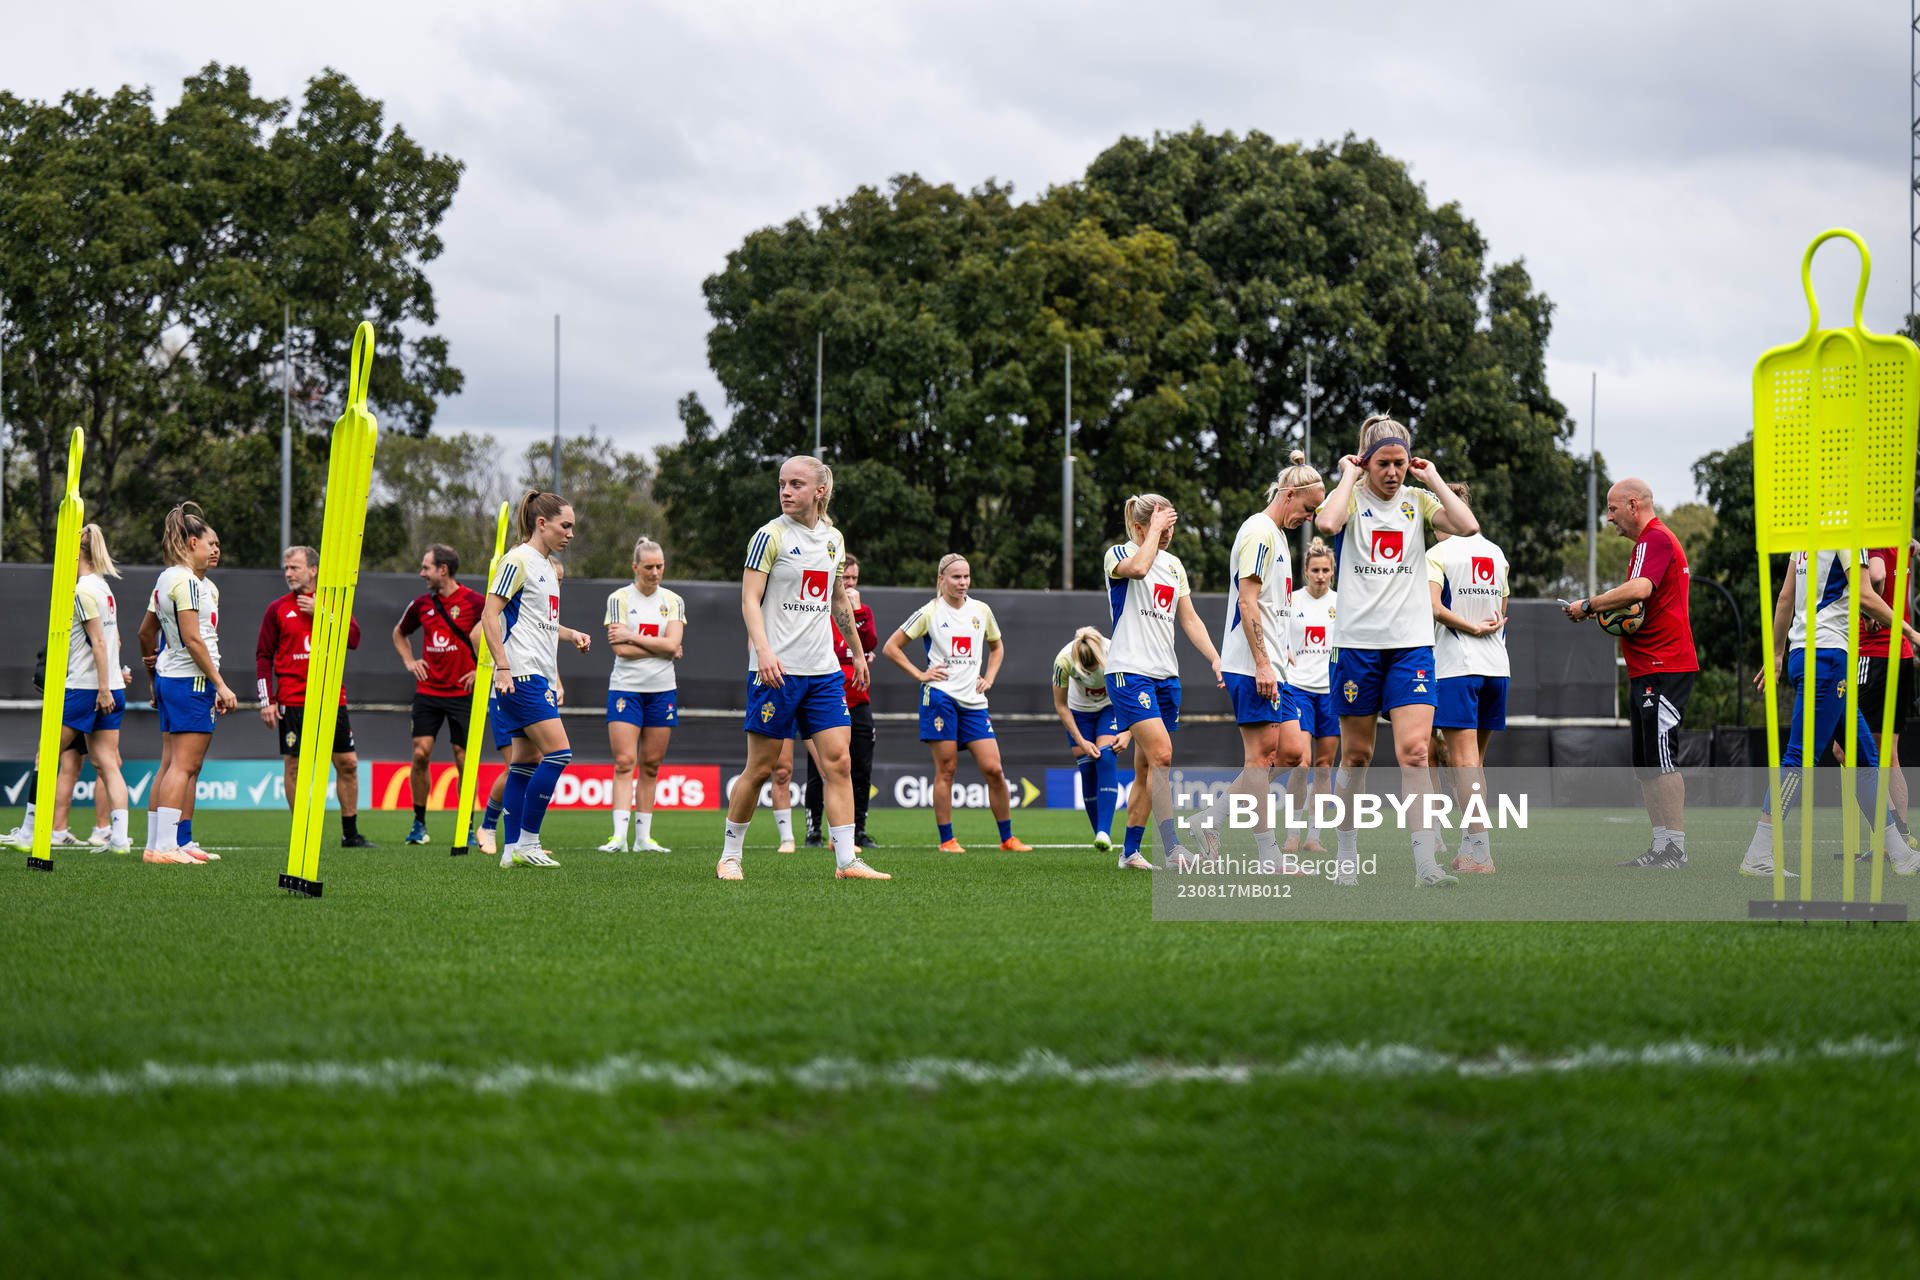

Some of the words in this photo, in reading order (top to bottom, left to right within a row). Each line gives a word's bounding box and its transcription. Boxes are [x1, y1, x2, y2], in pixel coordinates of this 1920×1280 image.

[1354, 565, 1395, 575] SVENSKA
[1396, 565, 1413, 575] SPEL
[1458, 587, 1490, 595] SVENSKA
[783, 602, 820, 612] SVENSKA
